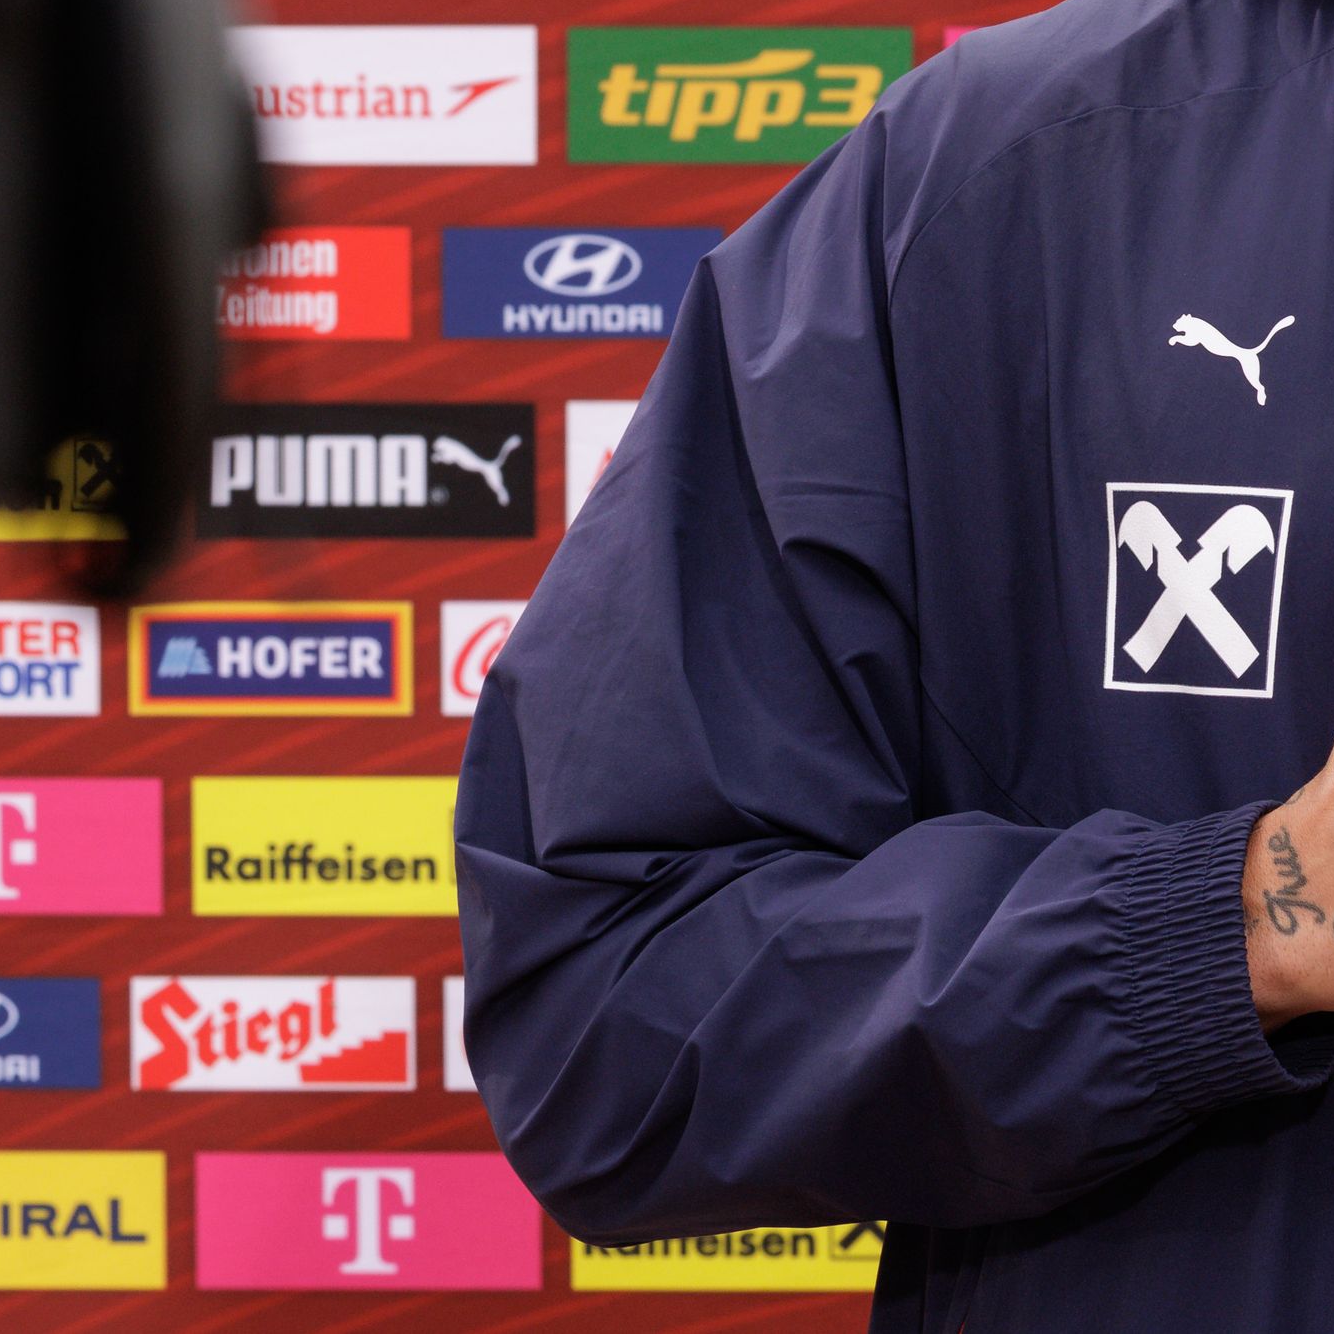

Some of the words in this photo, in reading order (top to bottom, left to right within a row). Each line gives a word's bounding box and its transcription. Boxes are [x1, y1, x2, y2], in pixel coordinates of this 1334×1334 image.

[253, 74, 433, 118] ustrian
[599, 49, 883, 141] tipp3
[504, 305, 662, 332] HYUNDAI
[212, 435, 427, 506] PUMA
[218, 637, 382, 678] HOFER
[205, 843, 436, 882] Raiffeisen
[139, 977, 337, 1090] Stiegl
[323, 1168, 414, 1274] T
